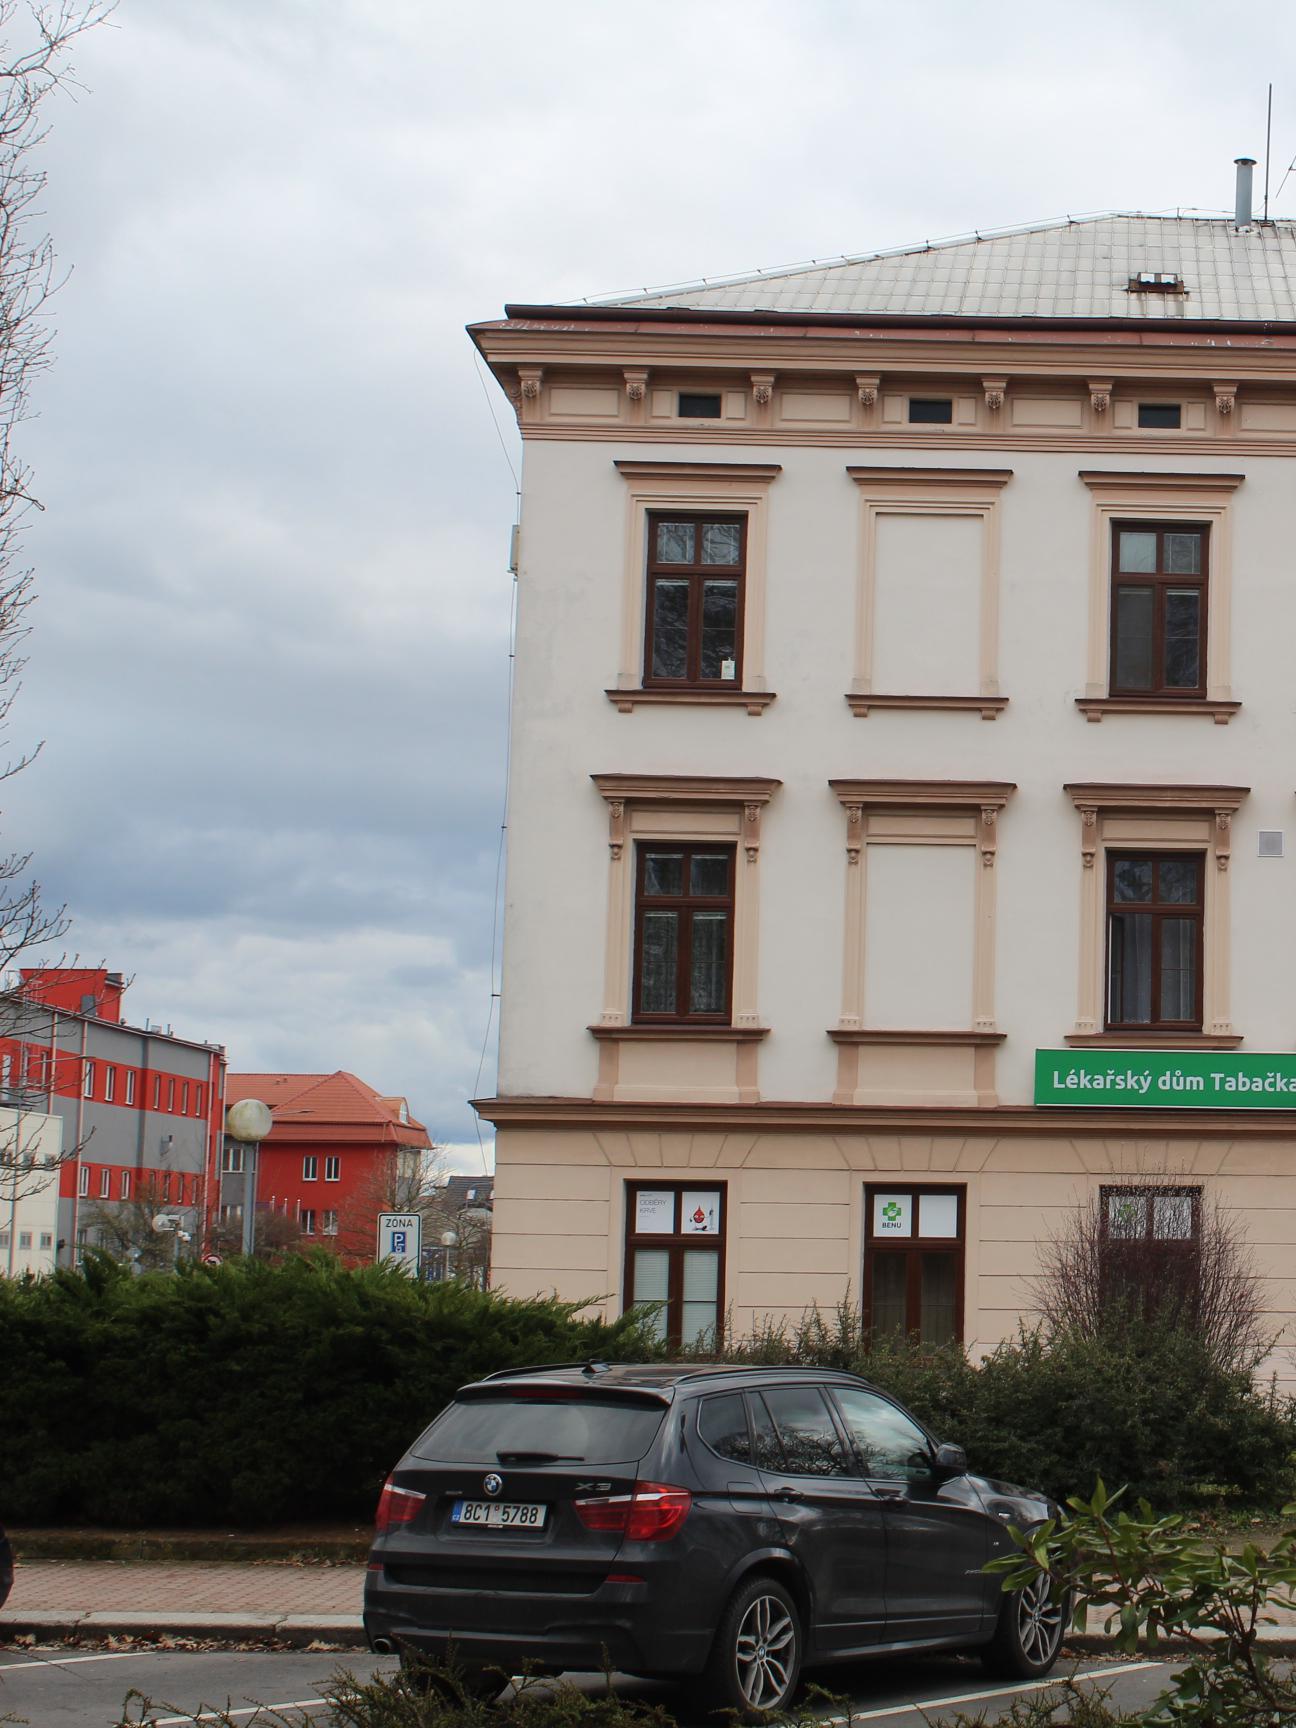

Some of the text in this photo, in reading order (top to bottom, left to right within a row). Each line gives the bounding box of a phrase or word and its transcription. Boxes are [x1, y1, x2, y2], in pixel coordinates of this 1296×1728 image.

[1053, 1069, 1152, 1094] Lékařský
[1158, 1070, 1204, 1091] dům
[385, 1217, 413, 1228] ZÓNA
[575, 1482, 612, 1491] X3
[464, 1503, 539, 1524] 8C1 5788
